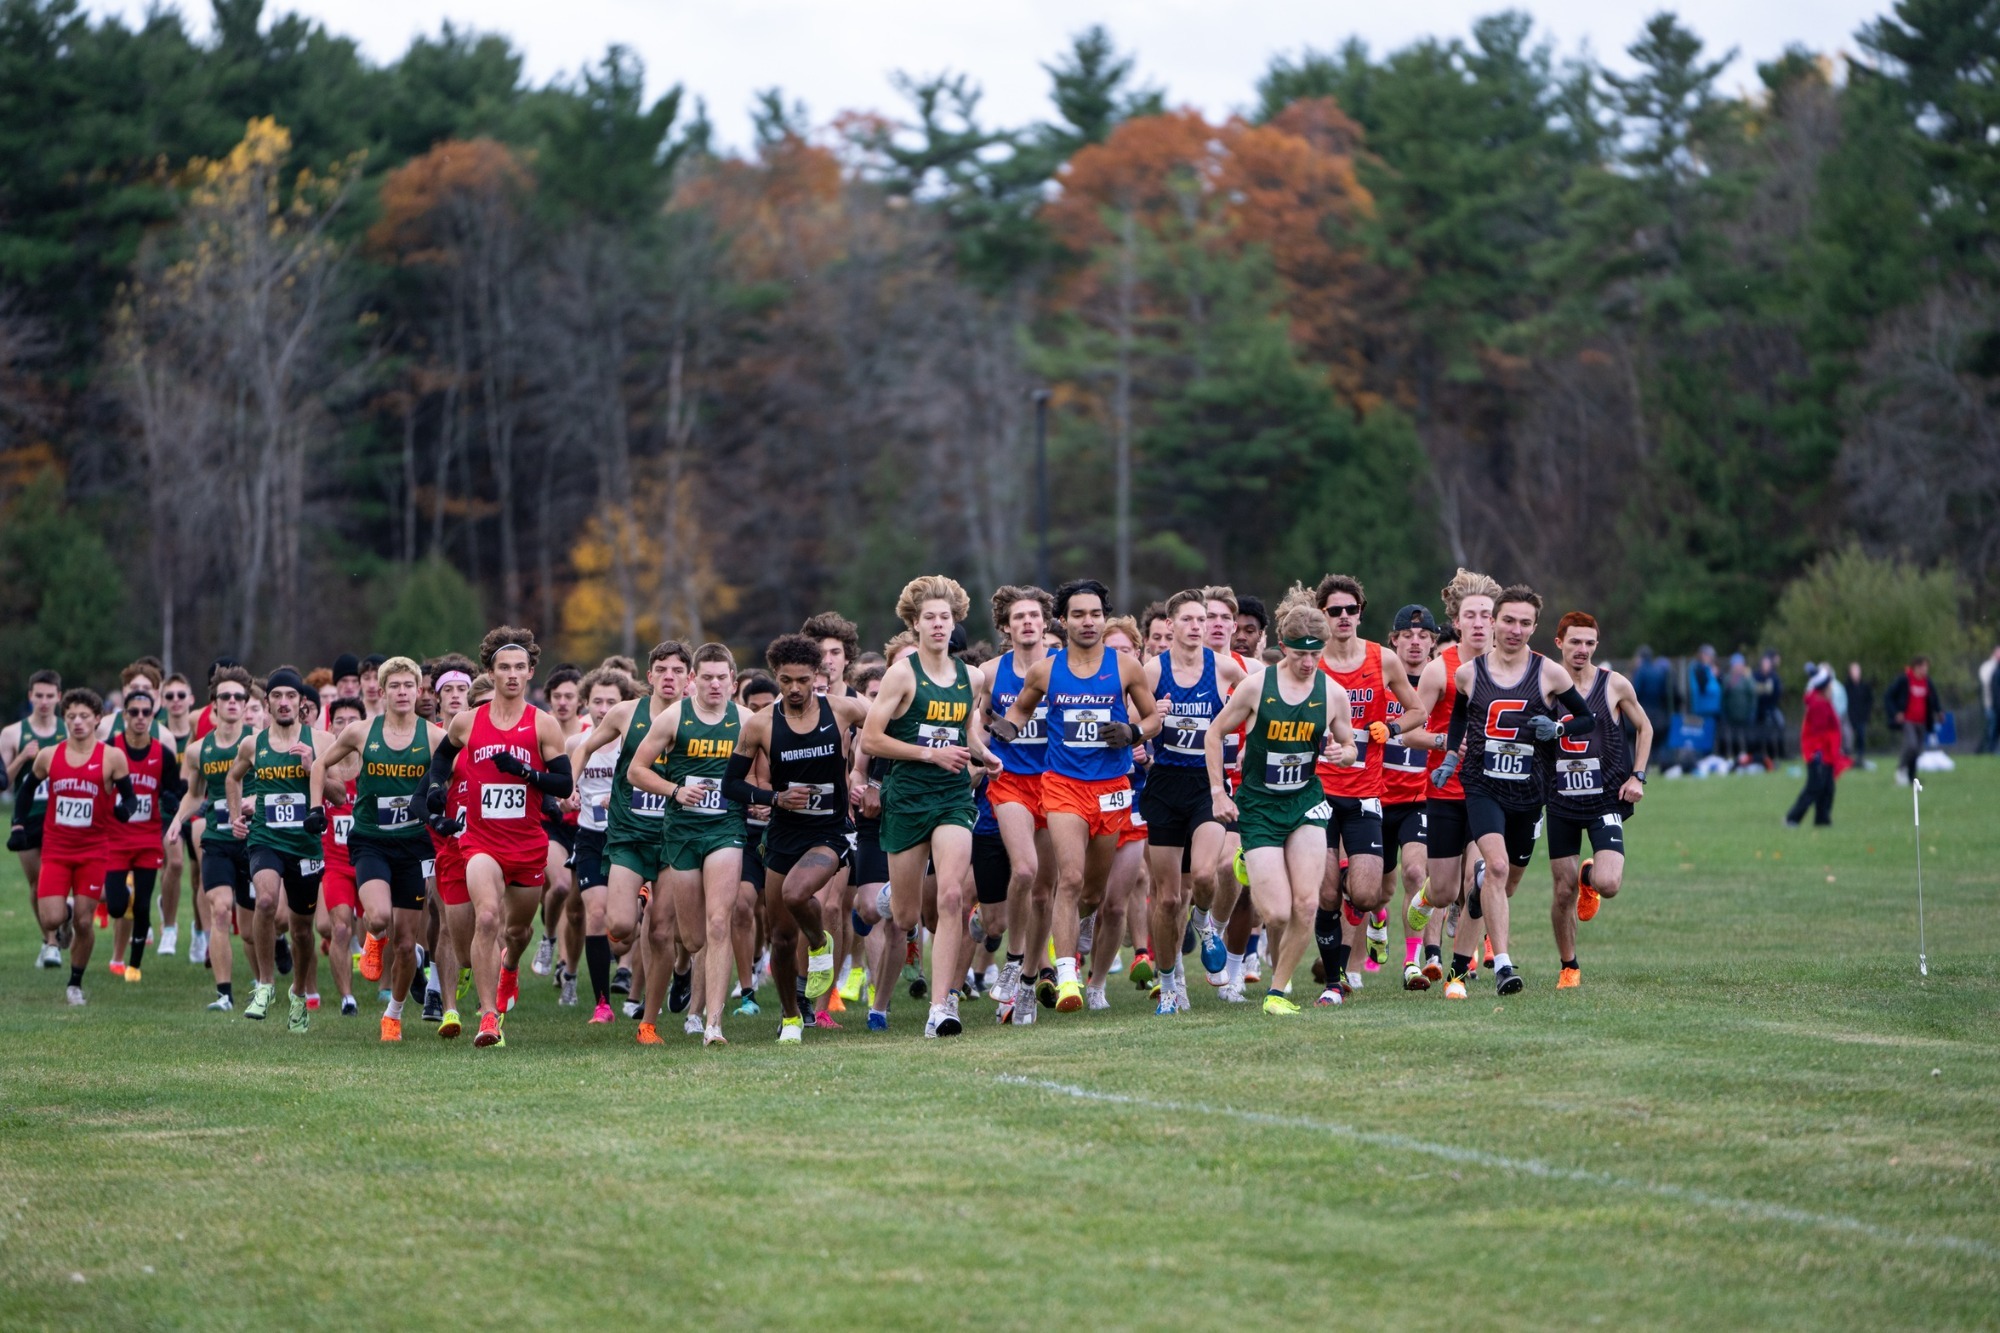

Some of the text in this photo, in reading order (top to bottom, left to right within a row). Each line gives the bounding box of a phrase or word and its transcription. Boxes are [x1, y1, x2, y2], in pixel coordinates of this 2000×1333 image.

[926, 701, 967, 721] DELHI
[1076, 722, 1098, 741] 49
[1177, 729, 1197, 748] 27
[1267, 720, 1315, 741] DELHI
[474, 744, 531, 764] CORTLAND
[687, 739, 734, 758] DELHI
[781, 744, 835, 761] MORRISVILLE
[203, 760, 235, 775] OSWE
[368, 762, 425, 777] OSWEGO
[1492, 753, 1523, 774] 105
[1277, 765, 1302, 784] 111
[1564, 770, 1594, 790] 106
[53, 778, 99, 796] CORTLAND
[482, 788, 525, 809] 4733
[694, 790, 720, 809] 08
[1110, 791, 1124, 807] 49
[57, 801, 92, 818] 4720
[275, 804, 295, 822] 69
[390, 807, 408, 824] 75
